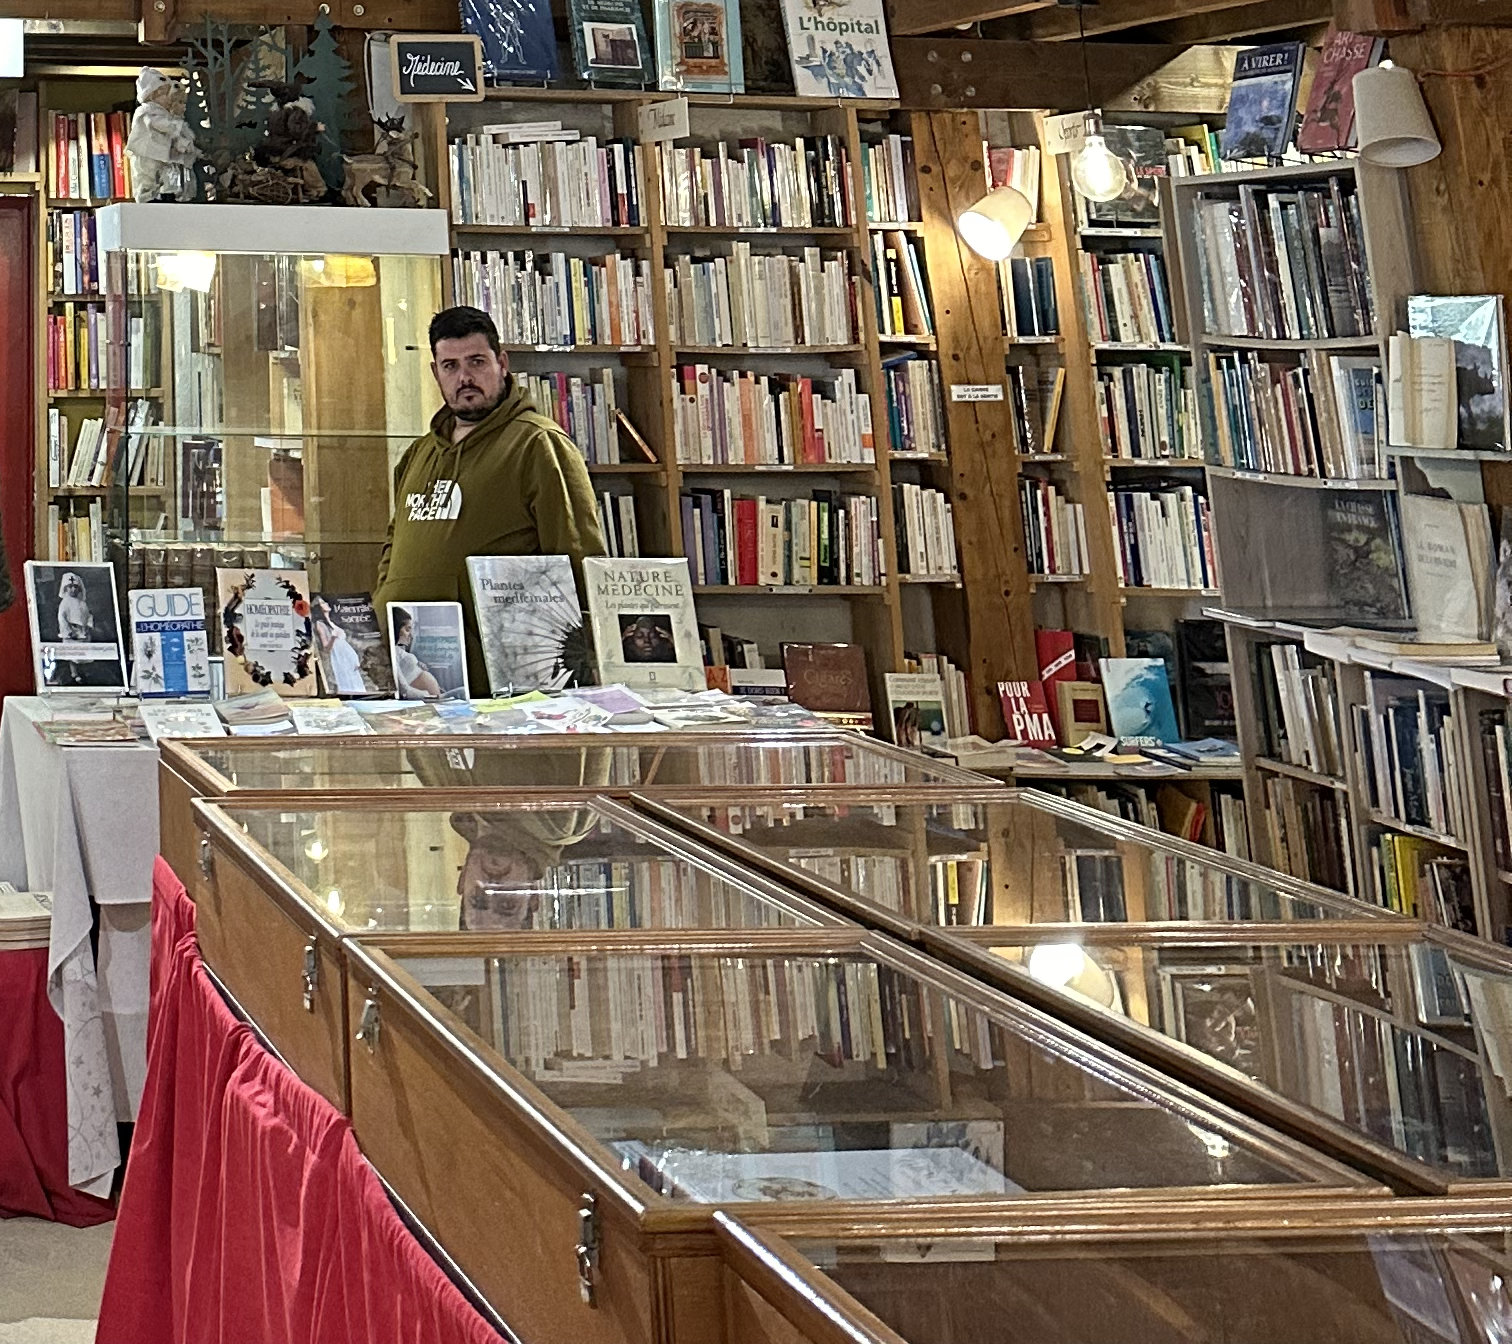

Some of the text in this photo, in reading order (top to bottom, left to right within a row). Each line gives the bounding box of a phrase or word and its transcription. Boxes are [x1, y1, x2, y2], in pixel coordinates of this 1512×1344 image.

[798, 16, 881, 36] L'hôpital
[408, 507, 436, 521] FACE
[481, 578, 525, 591] Plantes
[603, 570, 673, 583] NATURE
[136, 593, 202, 618] GUIDE
[997, 681, 1031, 698] POUR
[1010, 697, 1028, 715] LA
[1012, 713, 1056, 741] PMA
[1120, 735, 1157, 747] SURFERS
